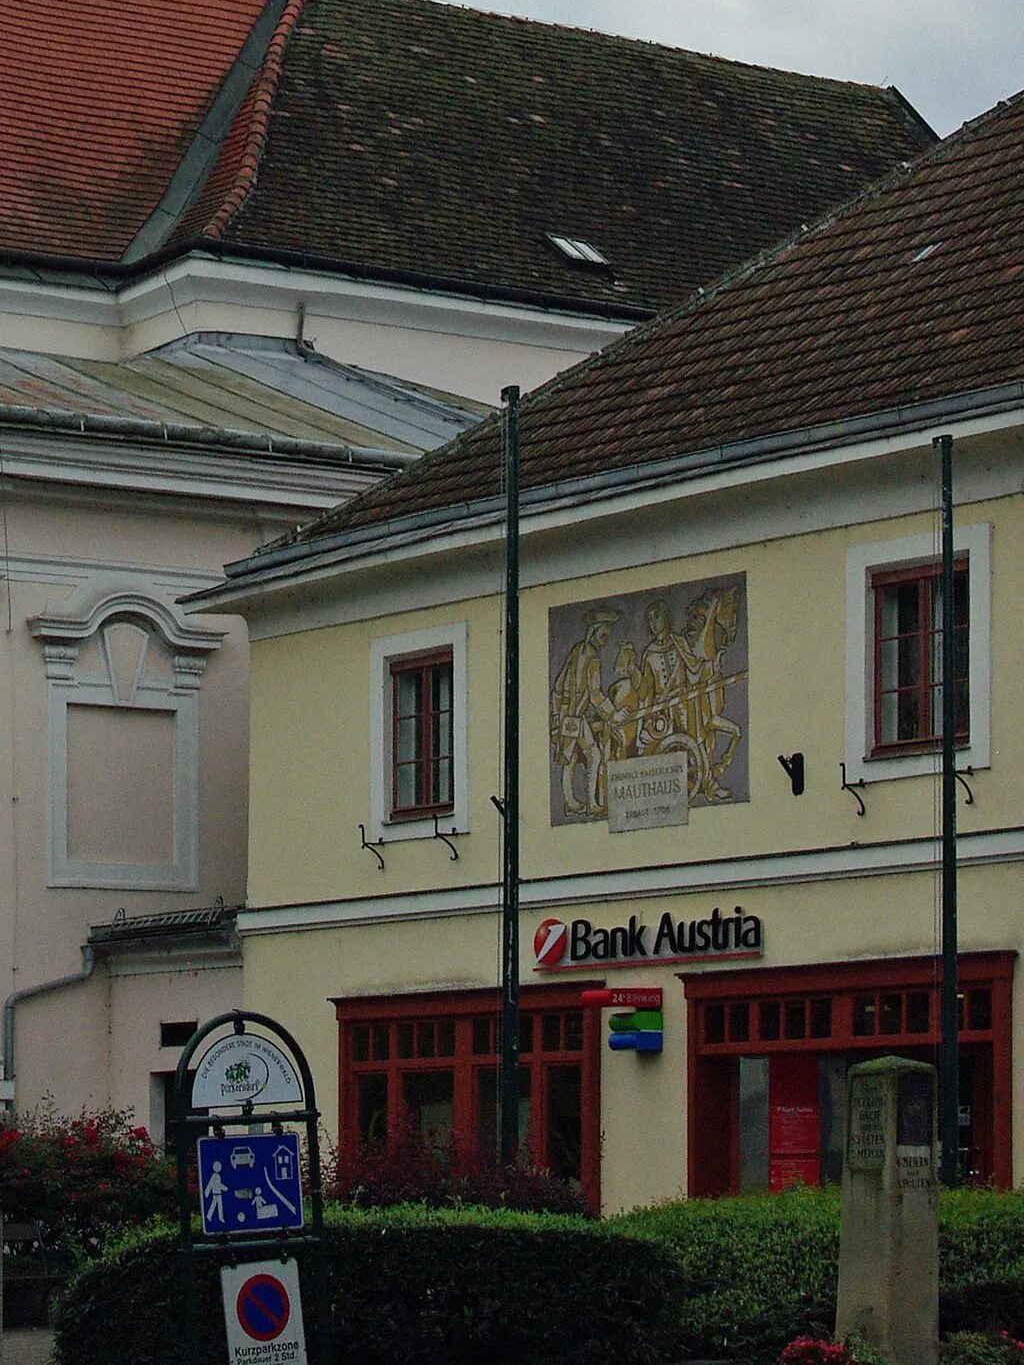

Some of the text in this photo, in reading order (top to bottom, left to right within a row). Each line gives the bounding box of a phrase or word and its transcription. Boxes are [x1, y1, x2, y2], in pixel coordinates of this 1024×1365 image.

[614, 778, 682, 800] MAUTHAUS
[570, 906, 761, 961] Bank Austria
[208, 1041, 236, 1067] BESONDERE
[236, 1040, 253, 1048] STADT
[253, 1041, 261, 1049] IM
[262, 1046, 291, 1084] WIENERWALD
[234, 1341, 299, 1357] Kurzparkzone
[237, 1351, 298, 1365] Parkdauer 2 Std.
